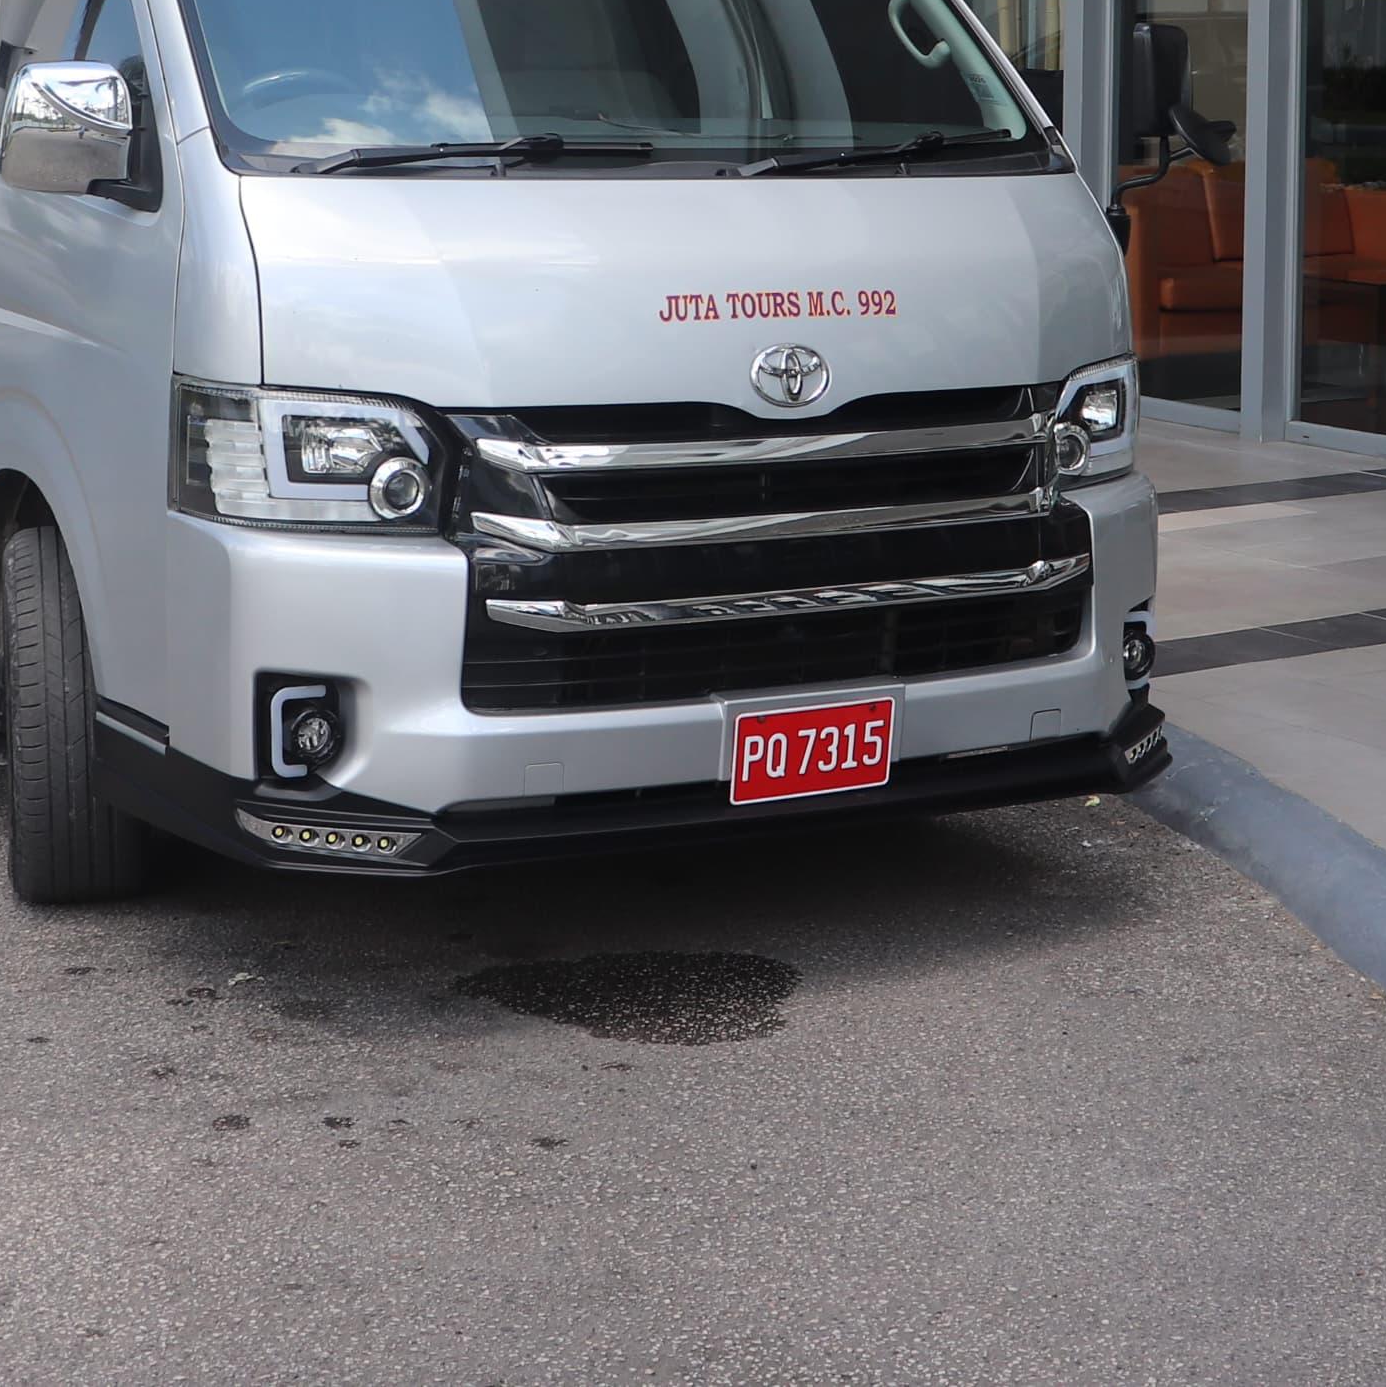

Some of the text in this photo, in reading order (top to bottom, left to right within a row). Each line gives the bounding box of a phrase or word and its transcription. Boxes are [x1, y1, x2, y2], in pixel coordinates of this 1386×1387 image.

[659, 290, 897, 322] JUTA TOURS M.C. 992
[741, 719, 885, 782] PQ 7315
